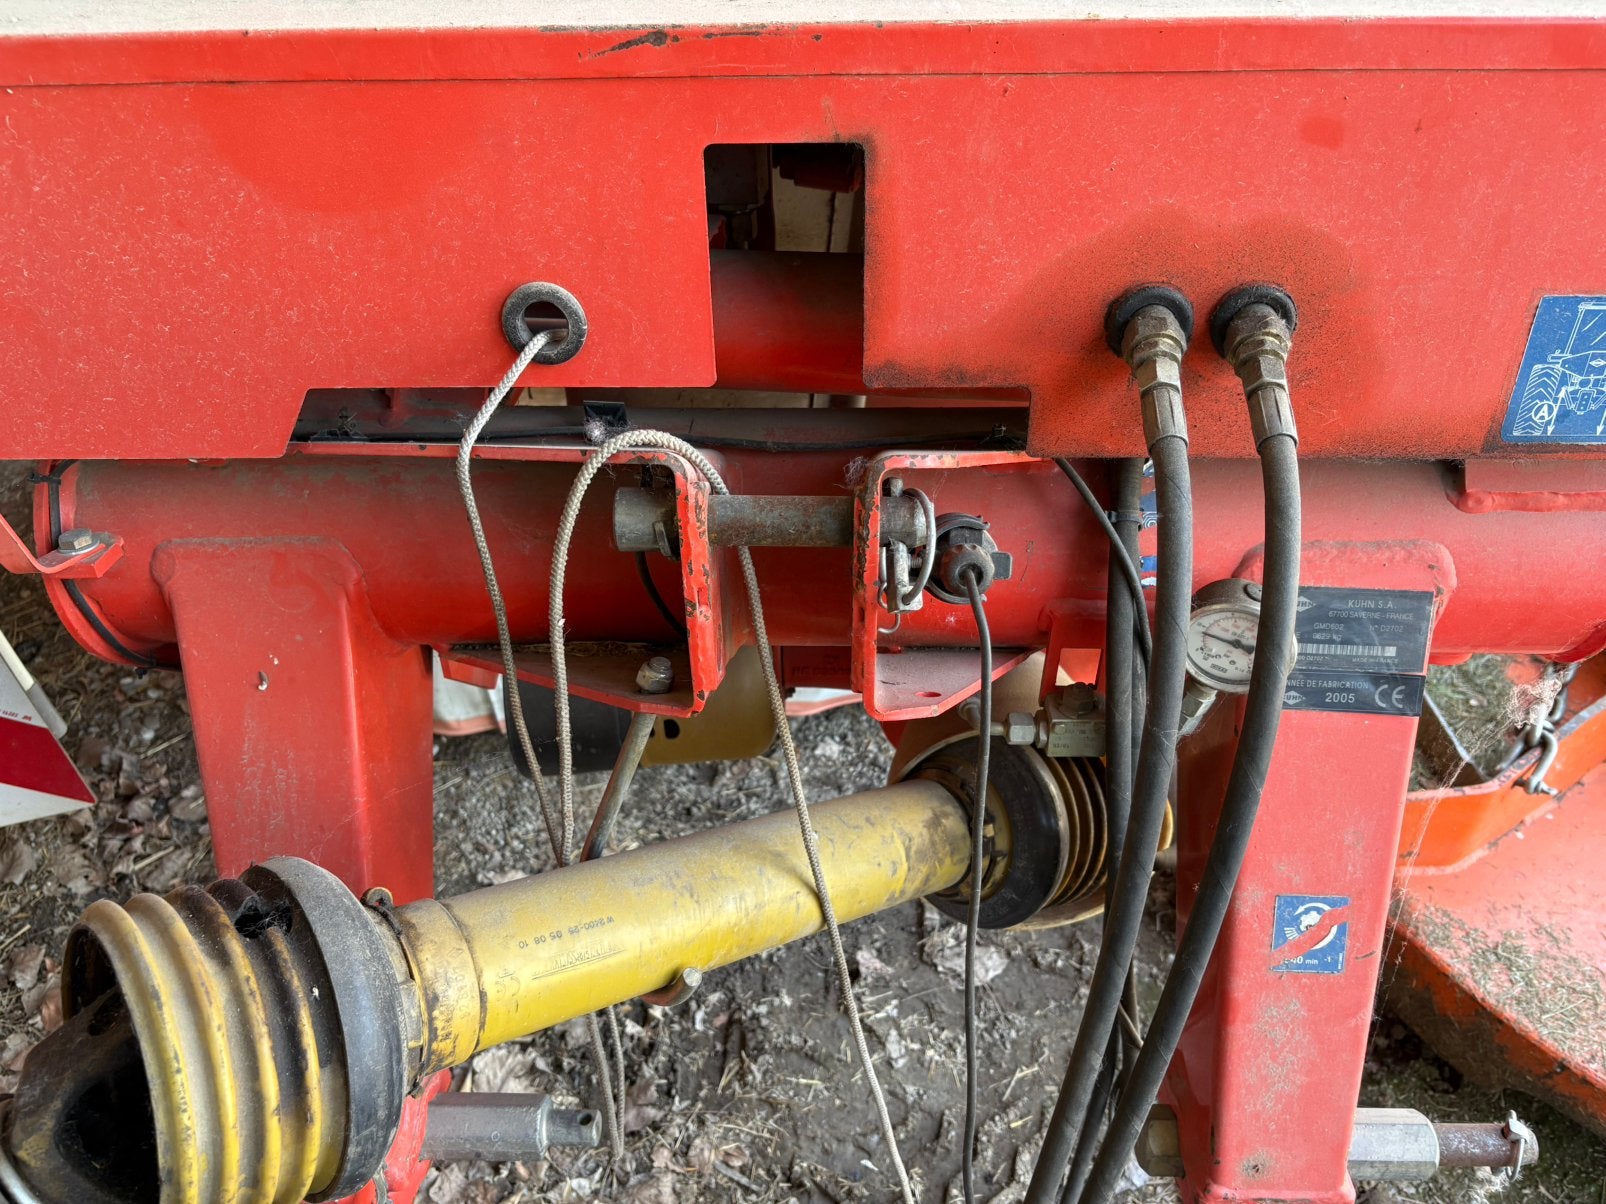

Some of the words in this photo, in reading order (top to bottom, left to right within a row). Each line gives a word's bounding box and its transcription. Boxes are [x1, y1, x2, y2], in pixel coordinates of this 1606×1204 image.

[1537, 404, 1549, 419] A
[1348, 599, 1376, 609] KUHN
[1377, 600, 1397, 609] S.A.
[1328, 610, 1348, 618] 67700
[1349, 611, 1381, 619] SAVERNE
[1386, 612, 1414, 620] FRANCE
[1380, 624, 1404, 632] D2702
[1286, 679, 1305, 687] NNEE
[1306, 679, 1316, 688] DE
[1318, 680, 1369, 689] FABRICATION
[1324, 692, 1355, 703] 2005
[1374, 684, 1406, 708] CE
[518, 939, 529, 949] 10
[533, 934, 547, 945] 08
